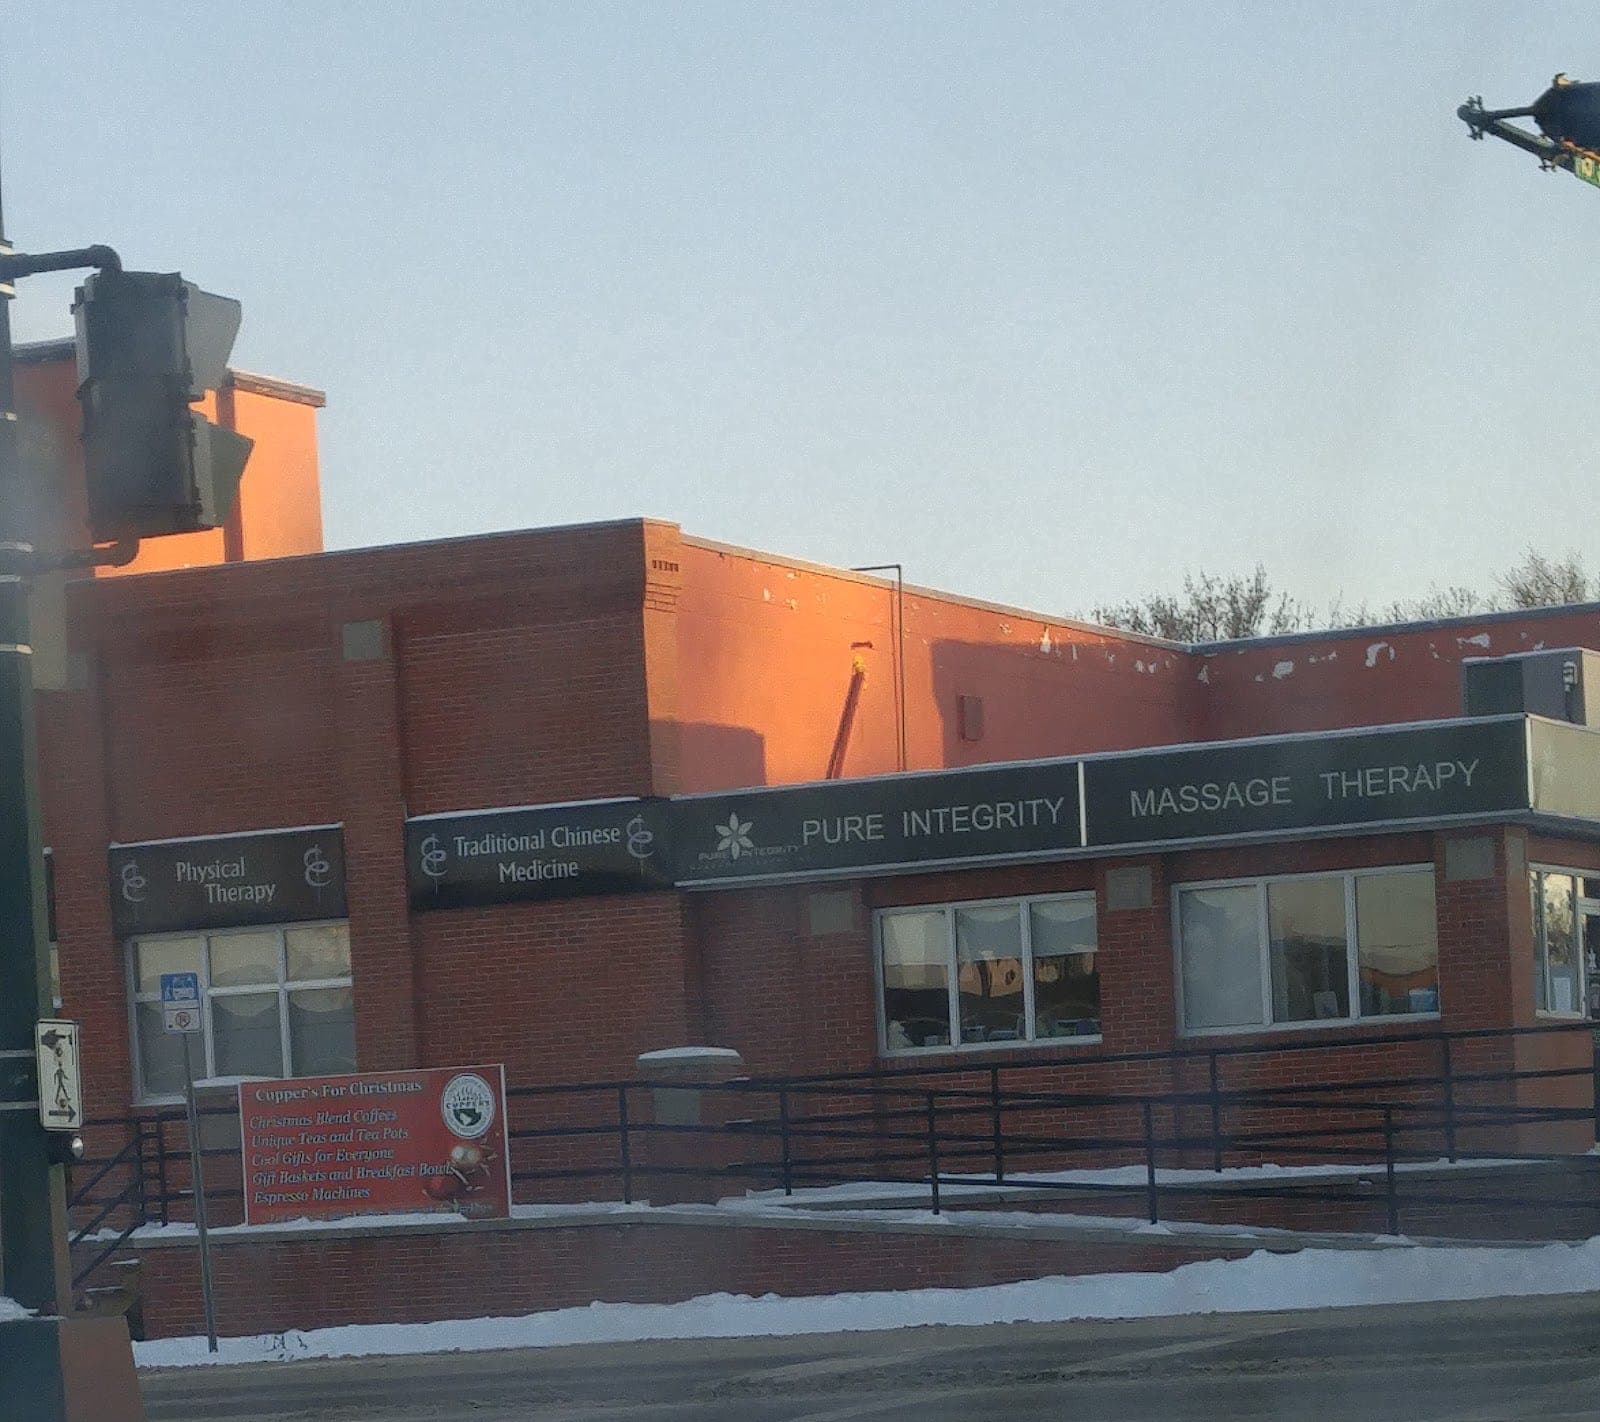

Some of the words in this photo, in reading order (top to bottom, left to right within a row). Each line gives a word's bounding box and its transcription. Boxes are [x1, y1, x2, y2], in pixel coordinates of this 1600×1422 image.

[1130, 776, 1292, 817] MASSAGE
[1319, 758, 1480, 800] THERAPY
[801, 813, 885, 847] PURE
[902, 796, 1065, 838] INTEGRITY
[452, 828, 547, 858] Traditional
[550, 823, 621, 849] Chinese
[175, 857, 246, 883] Physical
[497, 859, 579, 884] Medicine
[204, 879, 276, 905] Therapy
[256, 1085, 319, 1103] Cupper's
[323, 1084, 347, 1097] For
[350, 1080, 423, 1096] Christmas
[250, 1114, 313, 1129] Christmas
[316, 1110, 350, 1125] Blend
[353, 1109, 398, 1124] Coffees
[252, 1134, 295, 1150] Unique
[298, 1133, 327, 1146] Teas
[329, 1130, 353, 1144] and
[358, 1129, 381, 1142] Tea
[383, 1127, 409, 1140] Pots
[282, 1150, 311, 1167] Gifts
[313, 1148, 333, 1165] for
[336, 1148, 395, 1163] Everyone
[252, 1171, 277, 1187] Gift
[279, 1168, 327, 1184] Baskets
[329, 1166, 353, 1181] and
[356, 1163, 417, 1181] Breakfast
[254, 1191, 308, 1206] Espresso
[312, 1186, 371, 1201] Machines
